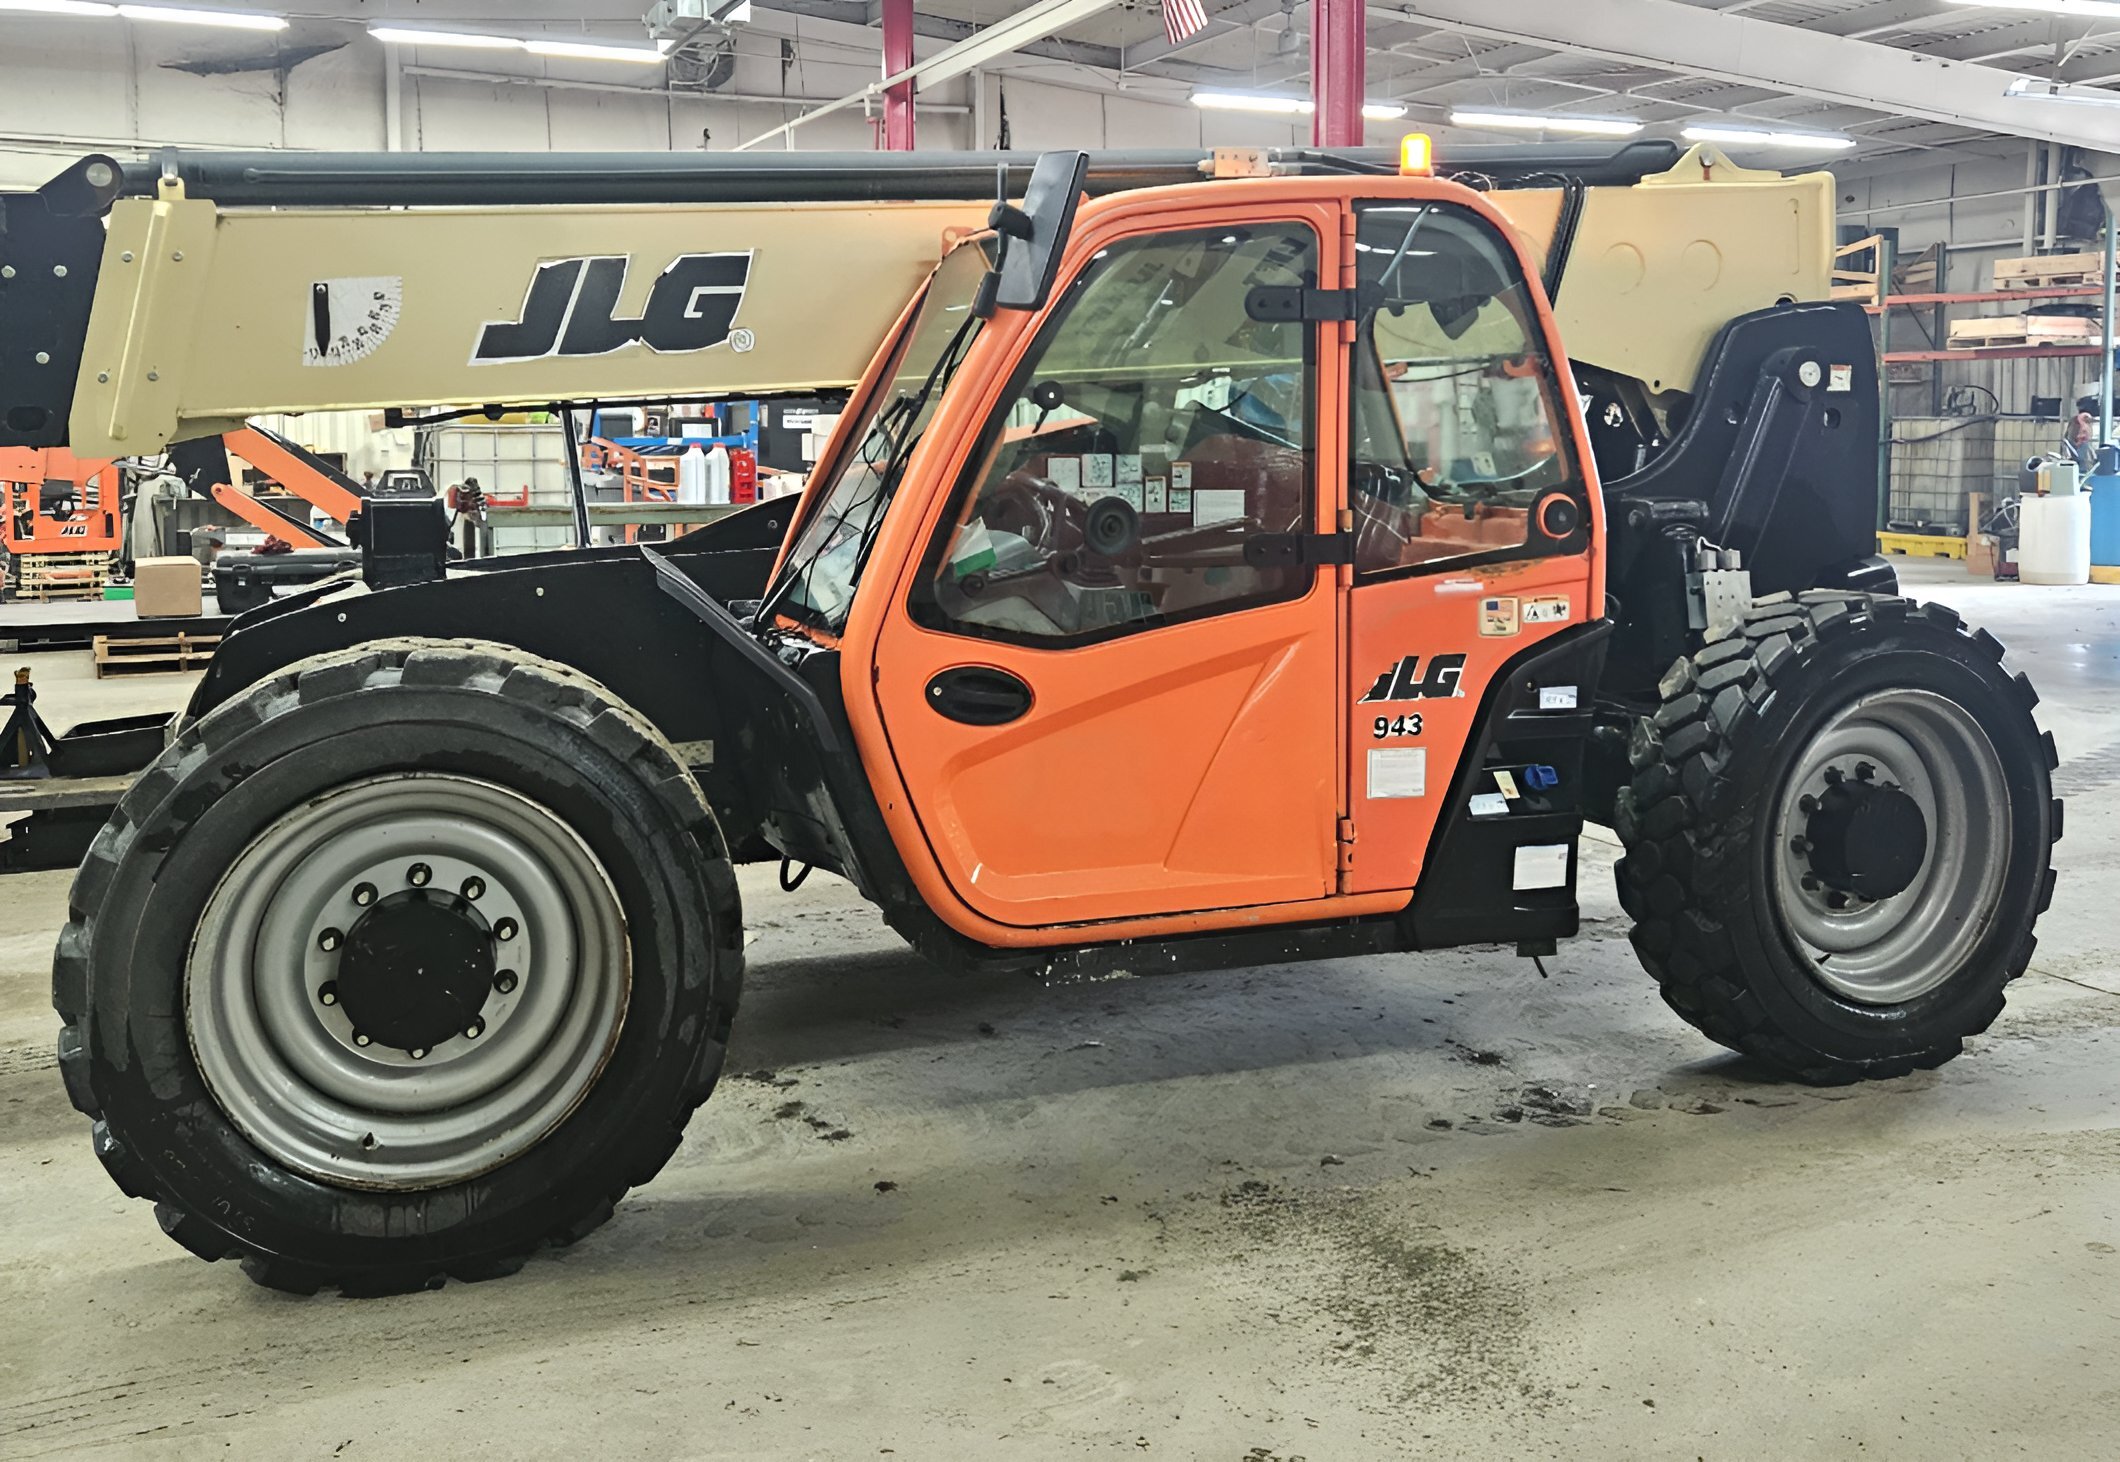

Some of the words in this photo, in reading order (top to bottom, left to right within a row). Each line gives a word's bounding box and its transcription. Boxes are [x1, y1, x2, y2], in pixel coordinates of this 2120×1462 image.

[468, 249, 754, 365] JLG
[1357, 653, 1466, 704] JLG
[1373, 712, 1423, 739] 943
